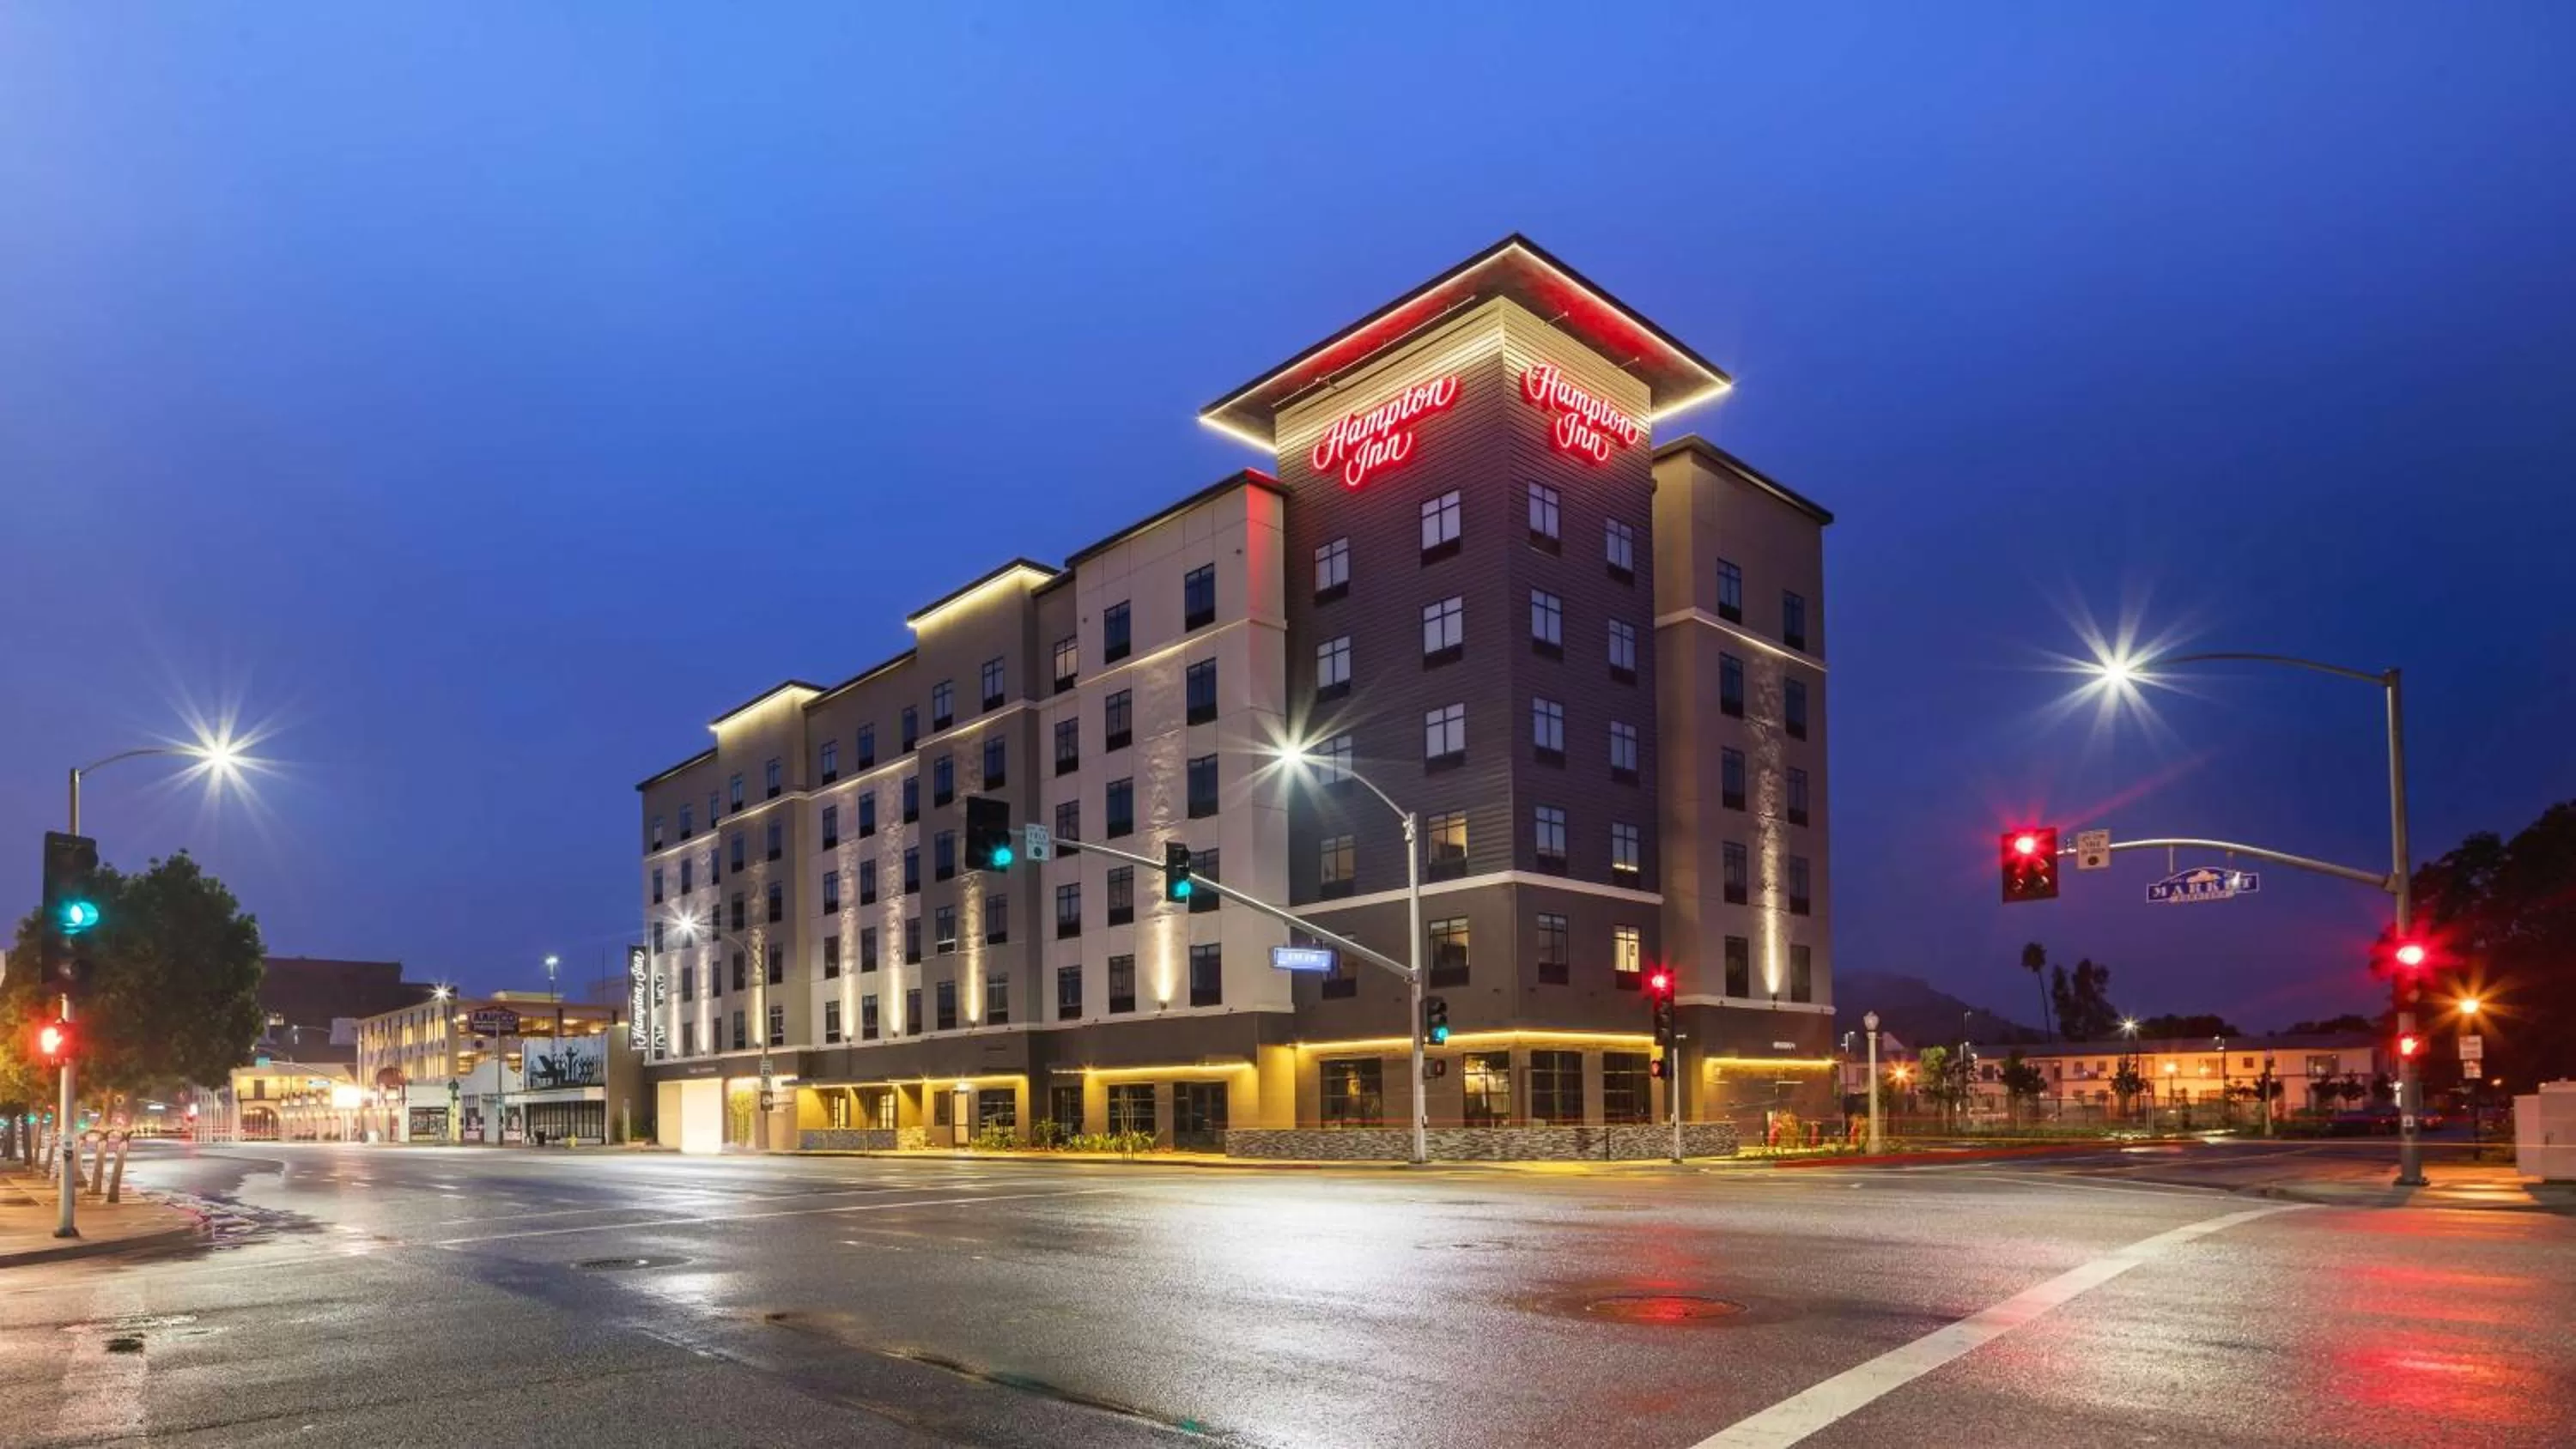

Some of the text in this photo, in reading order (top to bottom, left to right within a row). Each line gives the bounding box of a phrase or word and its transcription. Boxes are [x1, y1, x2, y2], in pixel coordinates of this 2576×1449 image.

[1312, 375, 1457, 470] Hampton
[1522, 363, 1641, 445] Hampton
[1556, 412, 1609, 461] Inn
[1345, 431, 1413, 487] Inn
